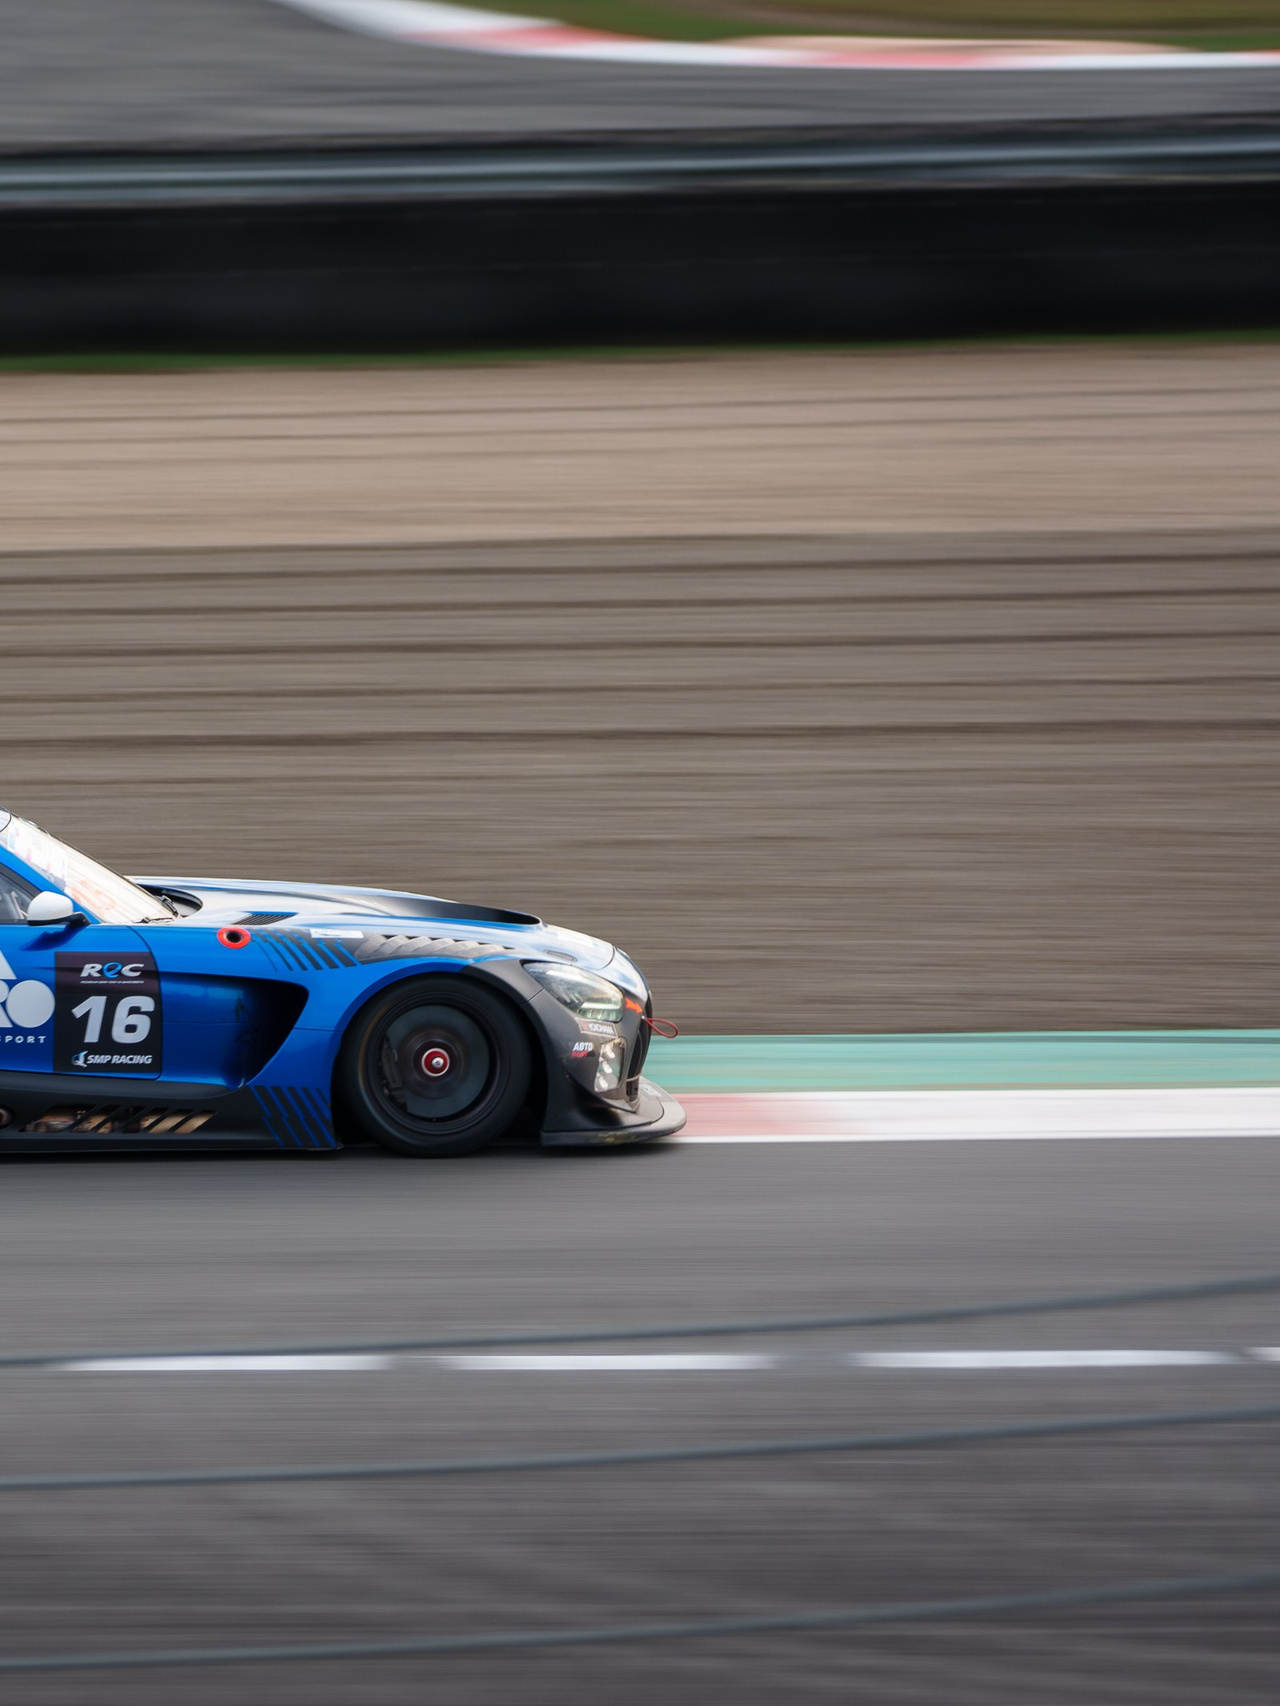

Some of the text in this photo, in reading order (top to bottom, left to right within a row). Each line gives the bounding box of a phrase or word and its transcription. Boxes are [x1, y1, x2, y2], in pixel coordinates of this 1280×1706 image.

[71, 995, 156, 1044] 16
[86, 1054, 153, 1065] SMP RACING
